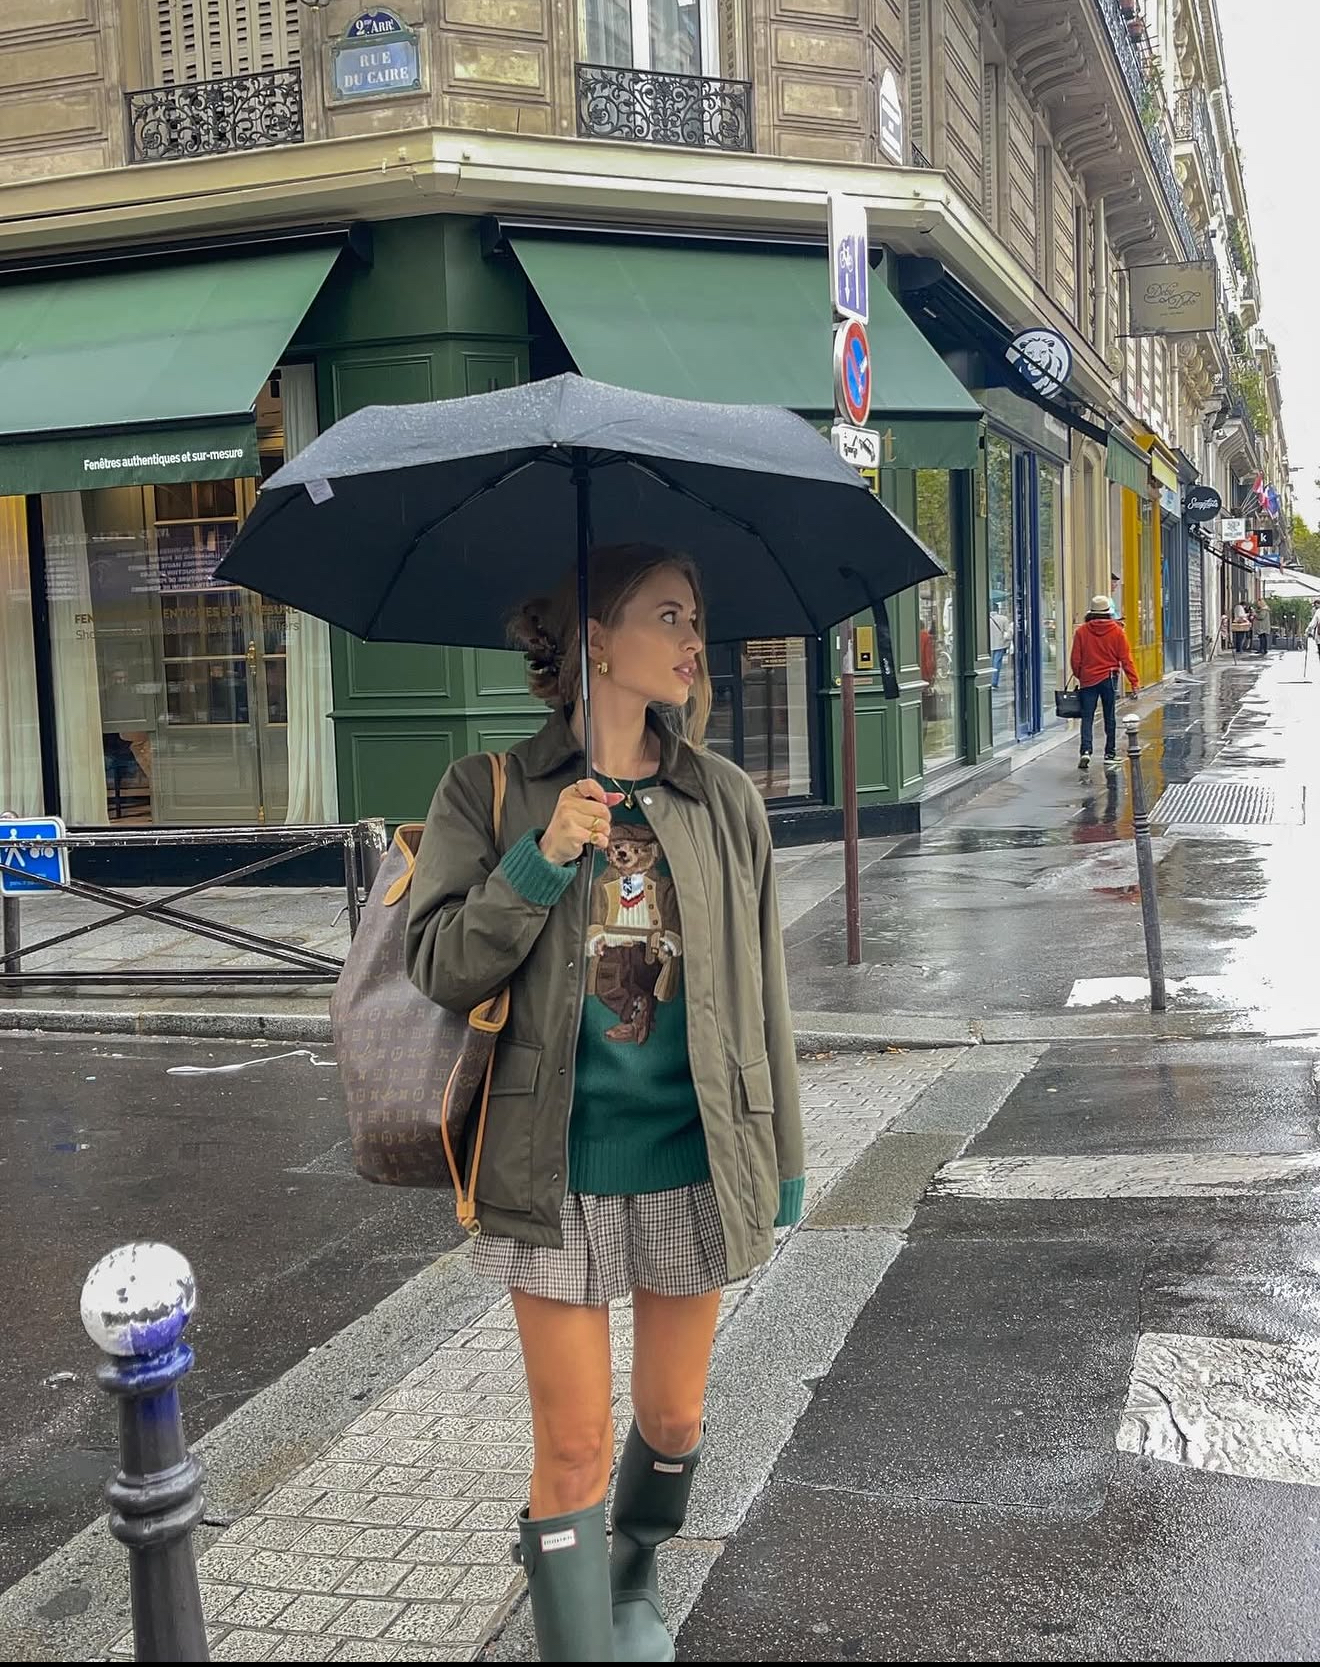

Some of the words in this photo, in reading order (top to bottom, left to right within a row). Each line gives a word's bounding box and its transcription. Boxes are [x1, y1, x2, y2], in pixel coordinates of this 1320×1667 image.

[360, 52, 391, 67] RUE
[344, 74, 363, 87] DU
[367, 67, 409, 83] CAIRE
[83, 457, 122, 471] Fenêtres
[122, 453, 181, 467] authentiques
[181, 451, 191, 463] et
[191, 448, 243, 462] sur-mesure
[1260, 532, 1267, 542] k
